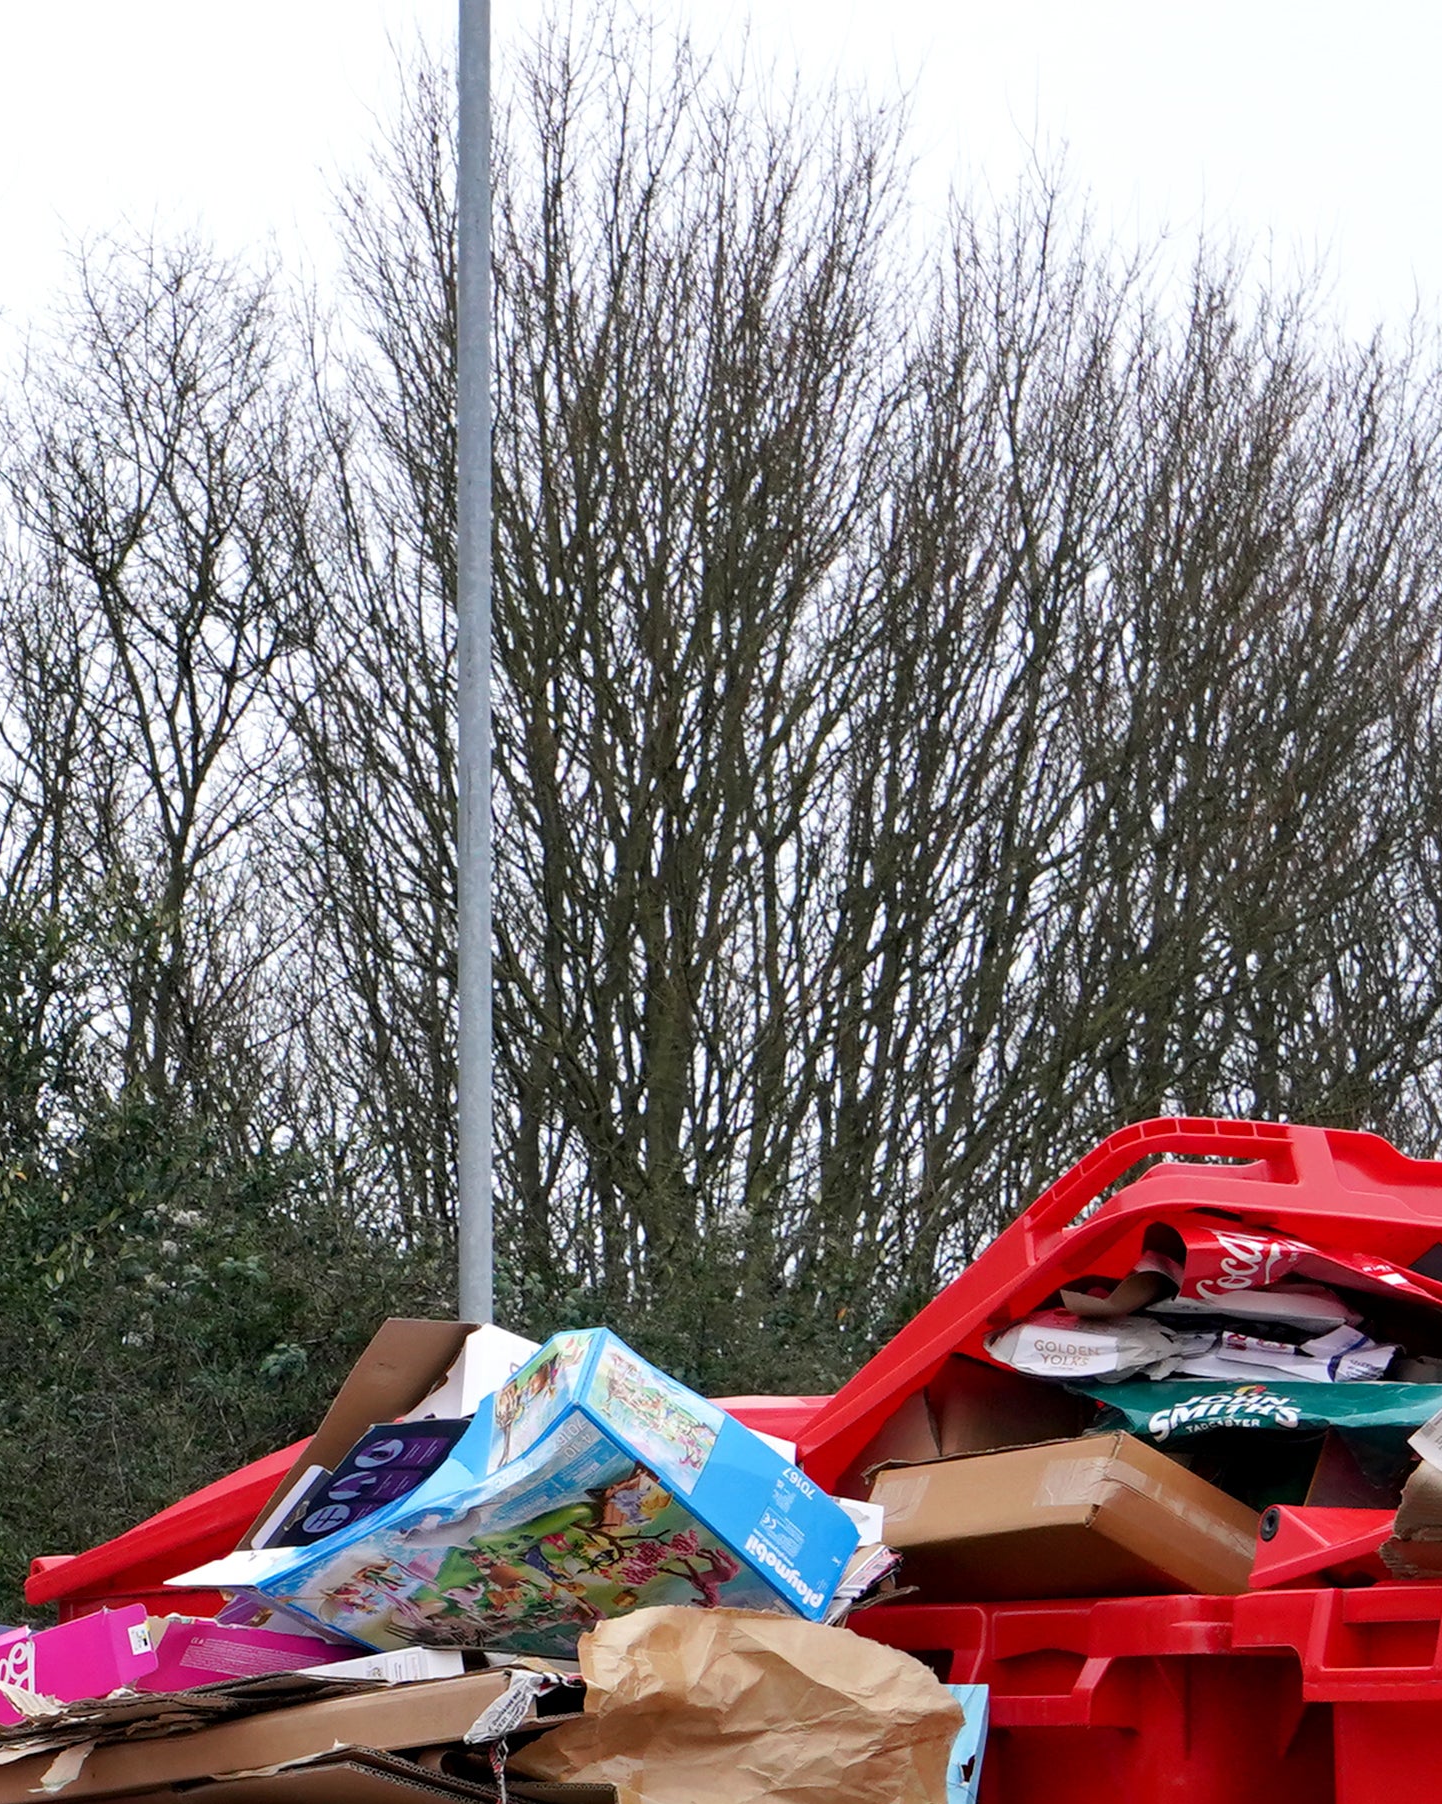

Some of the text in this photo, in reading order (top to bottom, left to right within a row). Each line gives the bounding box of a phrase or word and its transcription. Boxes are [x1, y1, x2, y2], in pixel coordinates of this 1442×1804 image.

[1033, 1339, 1100, 1359] GOLDEN
[1039, 1351, 1090, 1368] YOLKS
[1148, 1400, 1302, 1443] SMITH'S
[782, 1467, 817, 1501] 70167
[745, 1533, 825, 1609] playmobil
